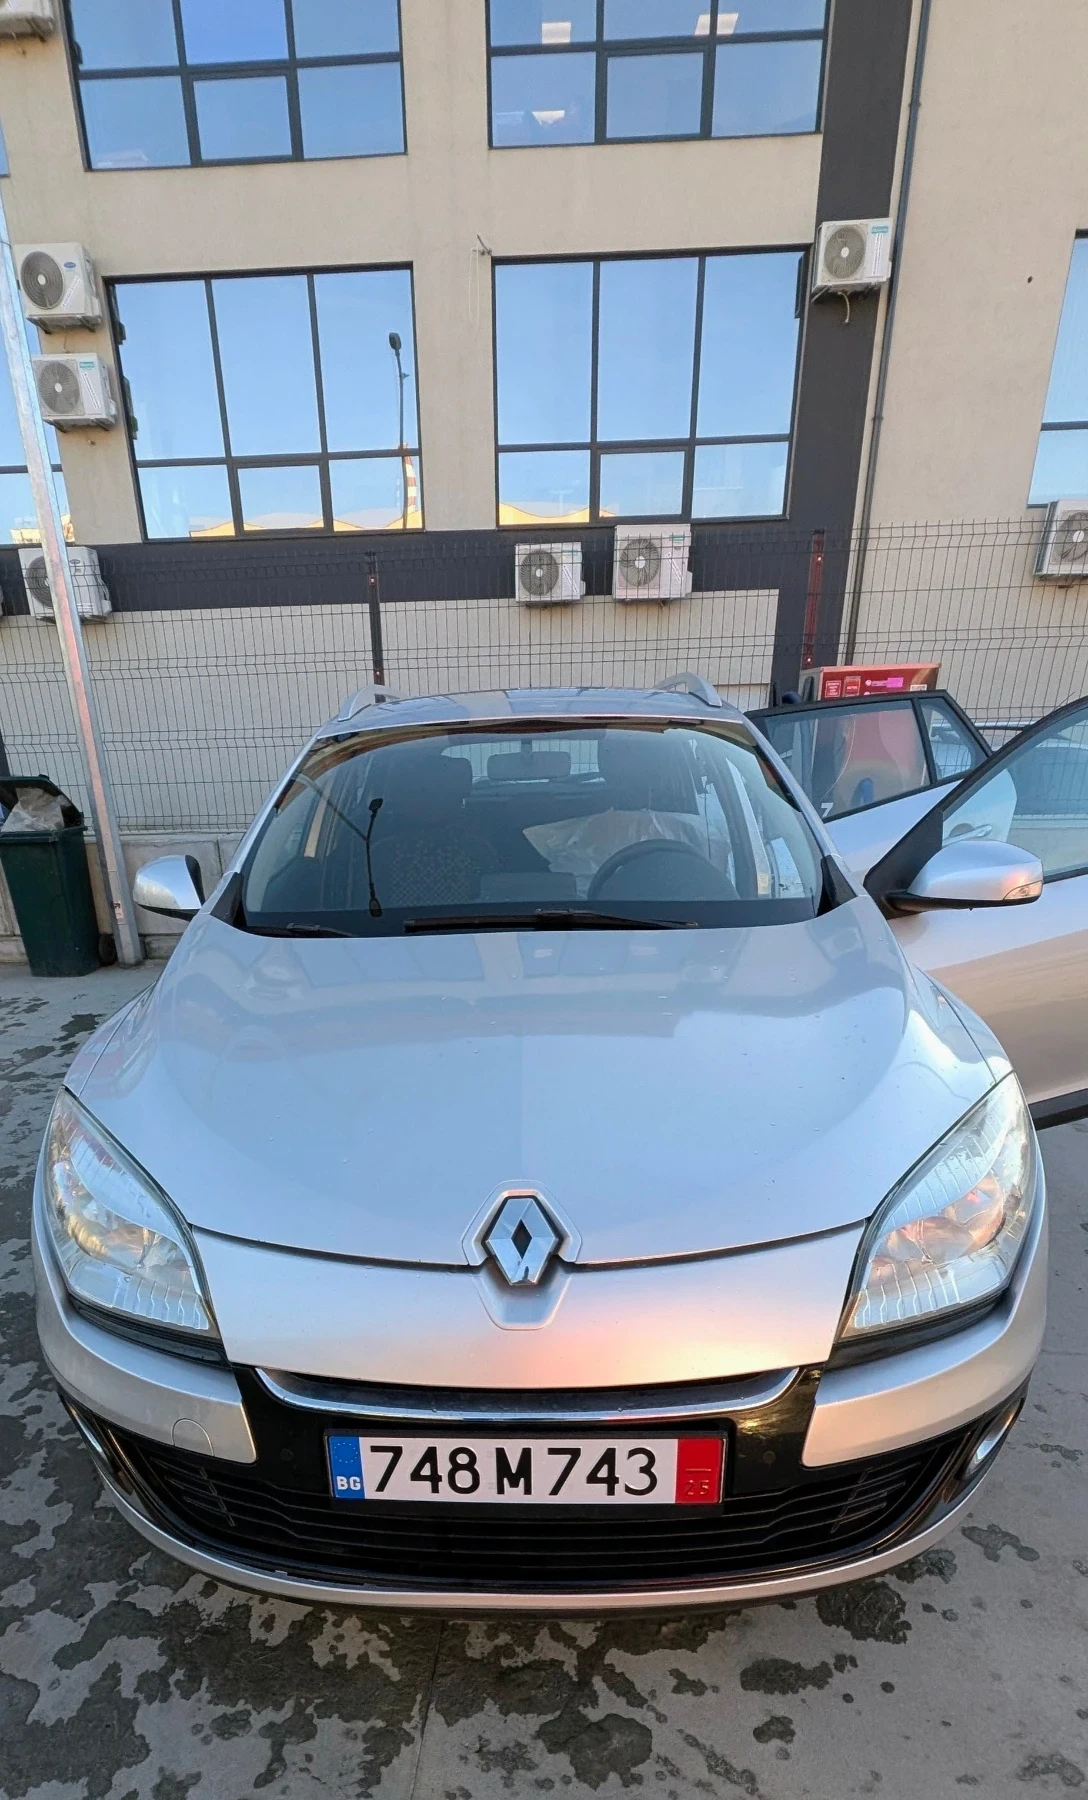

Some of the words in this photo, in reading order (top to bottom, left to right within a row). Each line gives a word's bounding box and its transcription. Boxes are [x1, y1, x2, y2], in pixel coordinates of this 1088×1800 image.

[370, 1445, 480, 1495] 748
[495, 1447, 532, 1496] M
[547, 1446, 658, 1496] 743
[336, 1476, 361, 1491] BG
[684, 1479, 710, 1496] 25
